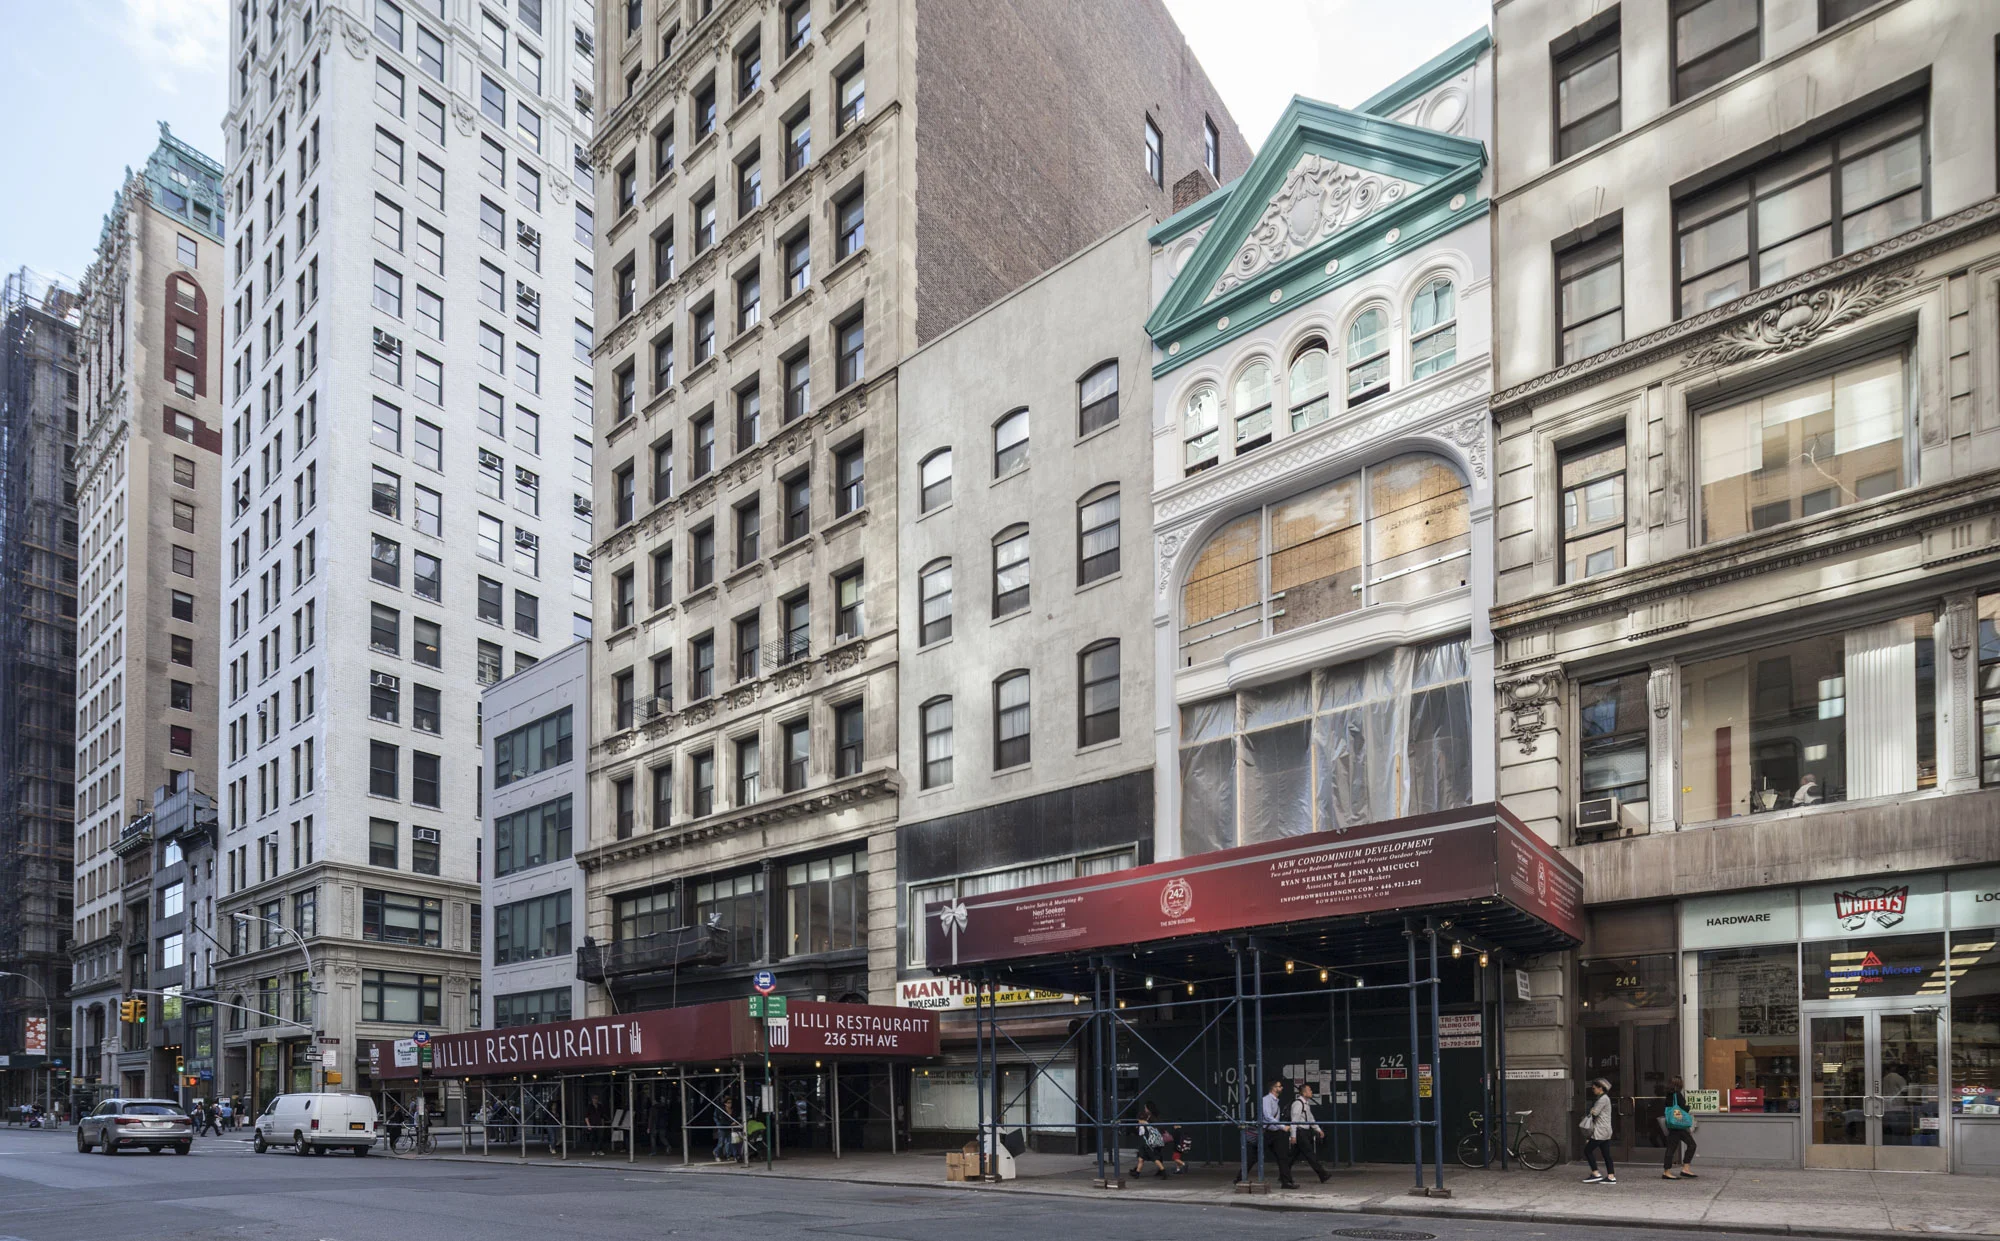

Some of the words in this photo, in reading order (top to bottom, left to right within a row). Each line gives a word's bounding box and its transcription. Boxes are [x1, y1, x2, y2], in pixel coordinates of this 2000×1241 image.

[1270, 863, 1276, 871] A
[1278, 859, 1296, 869] NEW
[1298, 848, 1362, 866] CONDOMINIUM
[1364, 838, 1434, 856] DEVELOPMENT
[1309, 864, 1332, 872] Bedroom
[1389, 852, 1414, 860] Outdoor
[1281, 878, 1299, 887] RYAN
[1302, 873, 1338, 883] SERHANT
[1348, 868, 1374, 878] JENNA
[1376, 861, 1419, 873] AMICUCCI
[1306, 882, 1332, 890] Associate
[1348, 876, 1366, 884] Estate
[1169, 888, 1184, 899] 242
[1316, 891, 1390, 904] BOWBUILDINGNY.COM
[1016, 903, 1036, 911] Exclusive
[1054, 898, 1076, 906] Marketing
[1706, 913, 1771, 926] HARDWARE
[1825, 967, 1879, 978] Benjamin
[1882, 965, 1922, 975] Moore
[1616, 977, 1637, 986] 244
[903, 981, 943, 999] MAN
[1000, 993, 1014, 1001] ART
[1025, 990, 1061, 999] ATIQUES
[908, 998, 950, 1008] WHOLESALERS
[836, 1015, 930, 1033] RESTAURANT
[486, 1024, 625, 1064] RESTAURANT
[824, 1033, 847, 1046] 236
[850, 1033, 873, 1046] 5TH
[877, 1034, 898, 1047] AVE
[1380, 1054, 1404, 1067] 242
[1689, 1102, 1702, 1110] EXIT
